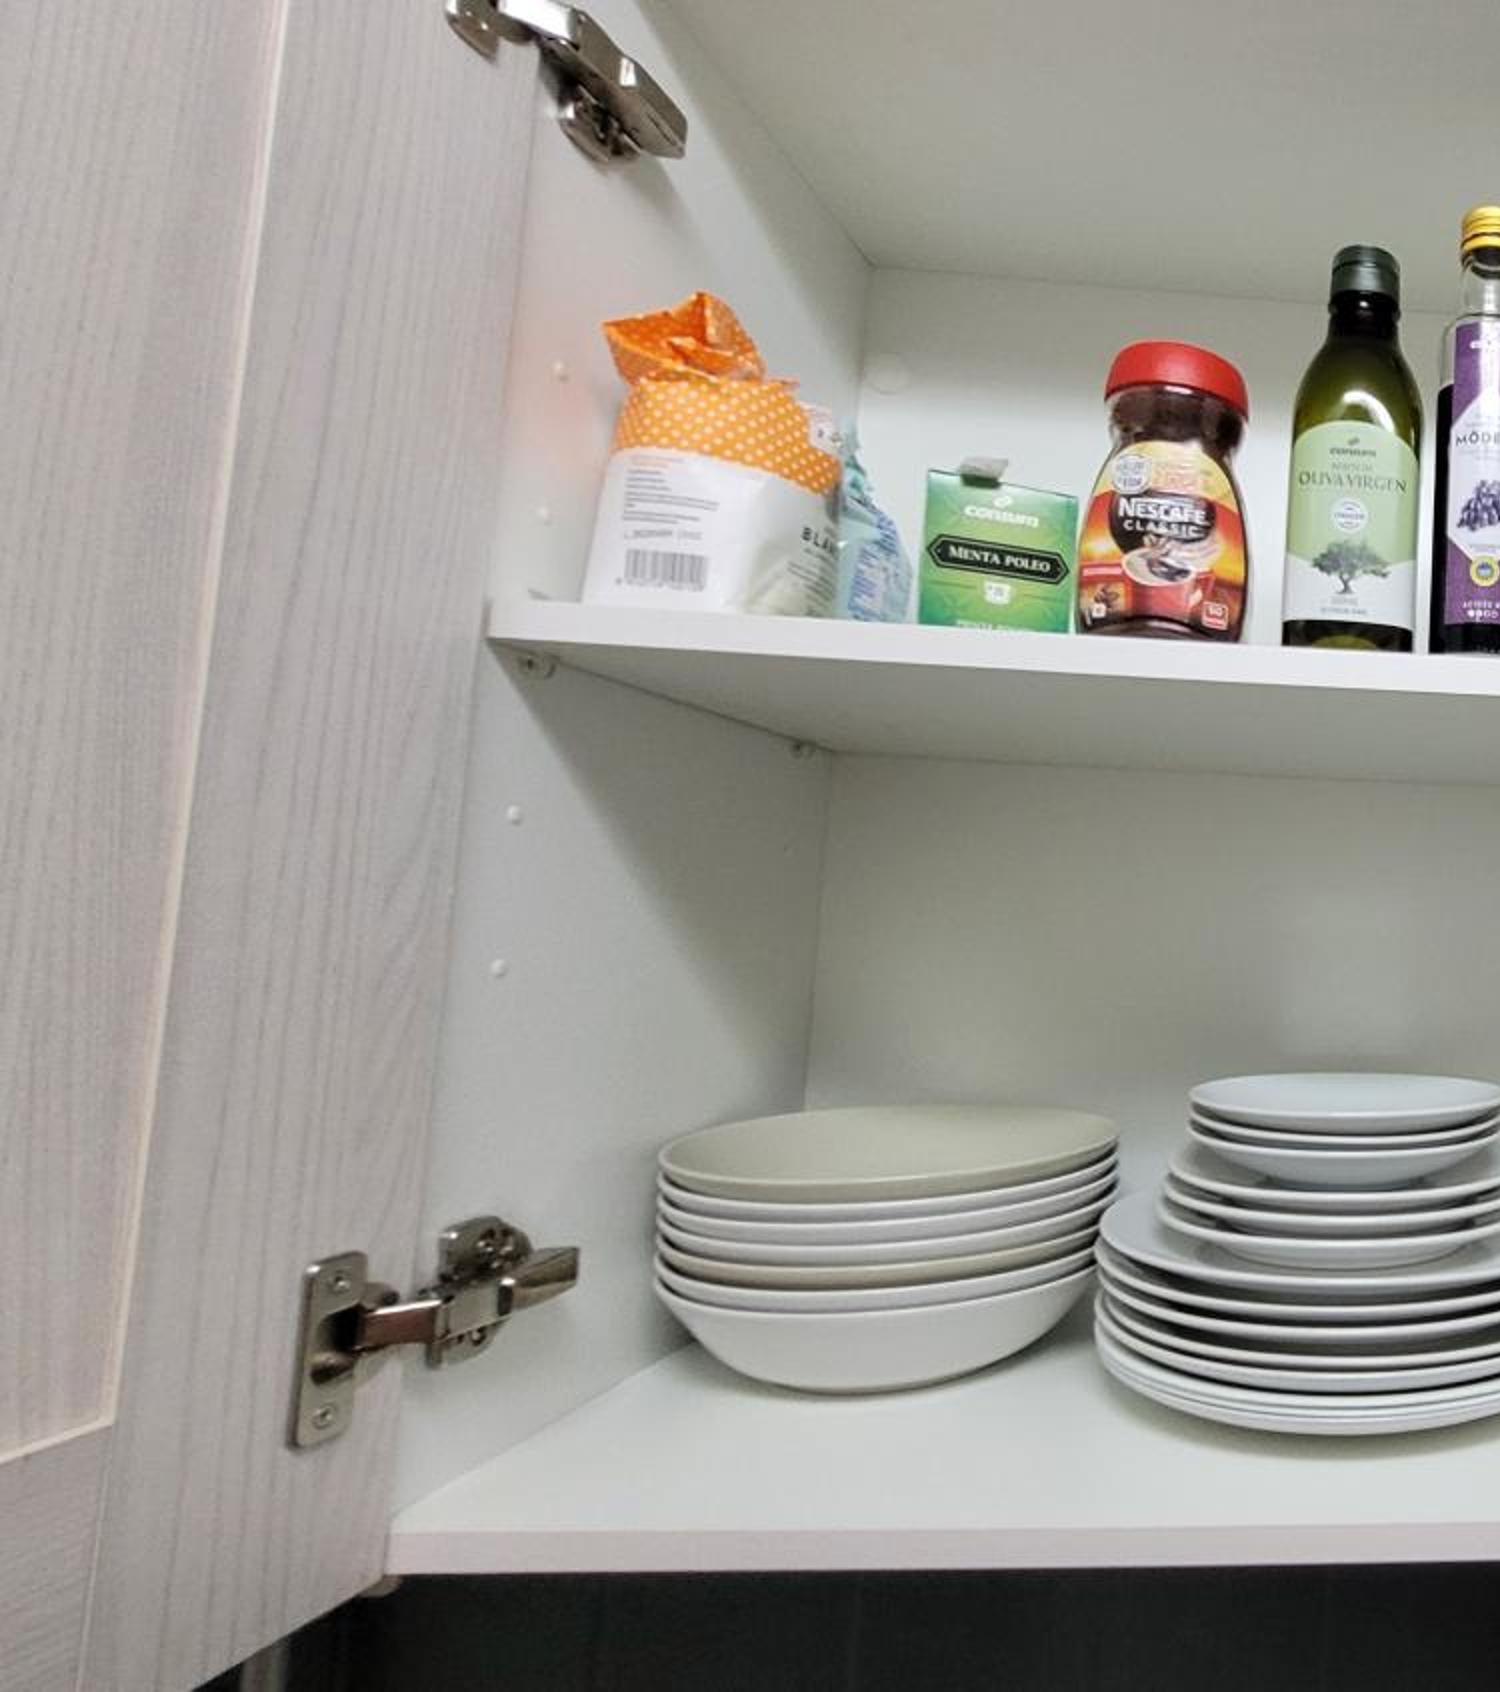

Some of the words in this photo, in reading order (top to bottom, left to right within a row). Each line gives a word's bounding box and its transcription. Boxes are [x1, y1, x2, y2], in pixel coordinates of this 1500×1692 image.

[1299, 471, 1344, 487] OLIVA
[1345, 474, 1407, 493] VIRGEN
[802, 526, 836, 554] BLA
[1123, 519, 1205, 538] CLASSIC
[948, 544, 1001, 566] MENTA
[1004, 555, 1051, 573] POLEO
